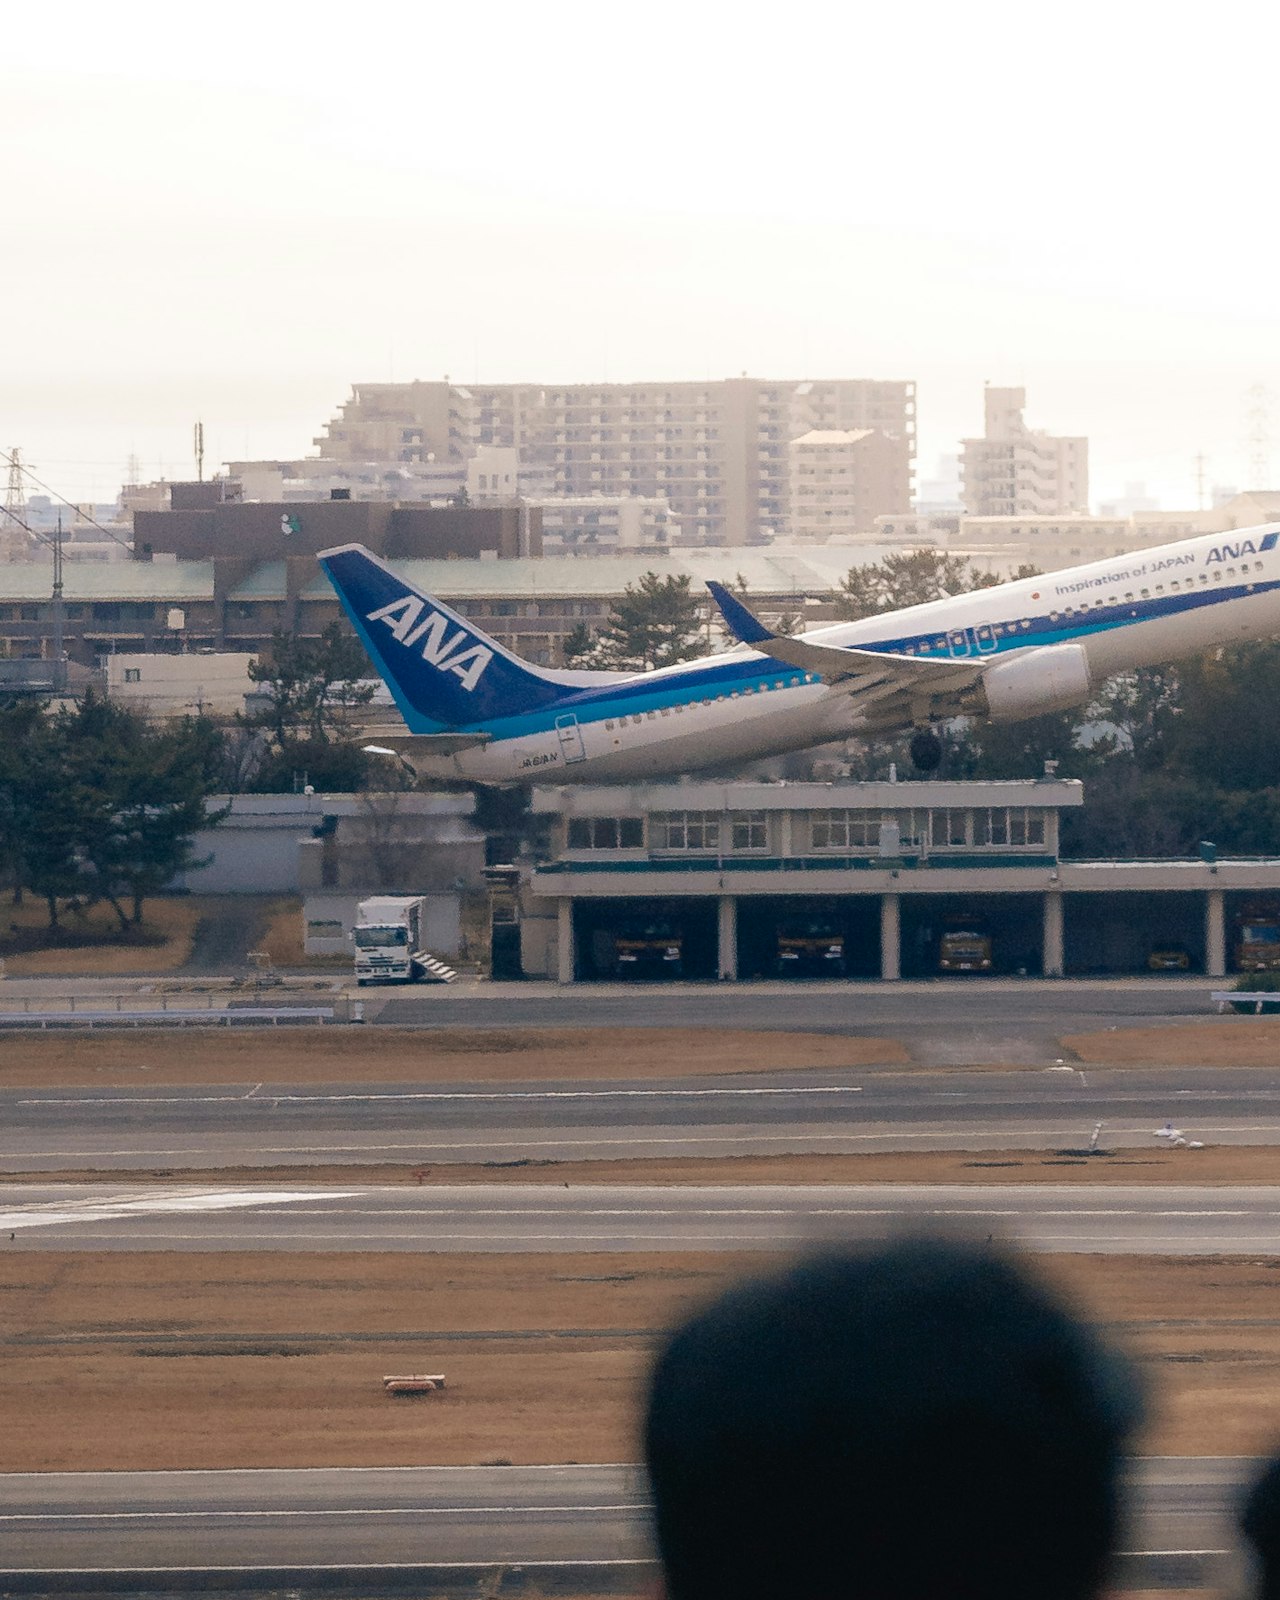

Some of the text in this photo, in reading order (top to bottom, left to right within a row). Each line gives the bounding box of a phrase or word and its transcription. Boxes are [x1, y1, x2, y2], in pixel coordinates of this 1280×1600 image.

[1205, 539, 1257, 565] ANA
[1055, 553, 1195, 596] Inspiration of JAPAN
[366, 594, 494, 692] ANA
